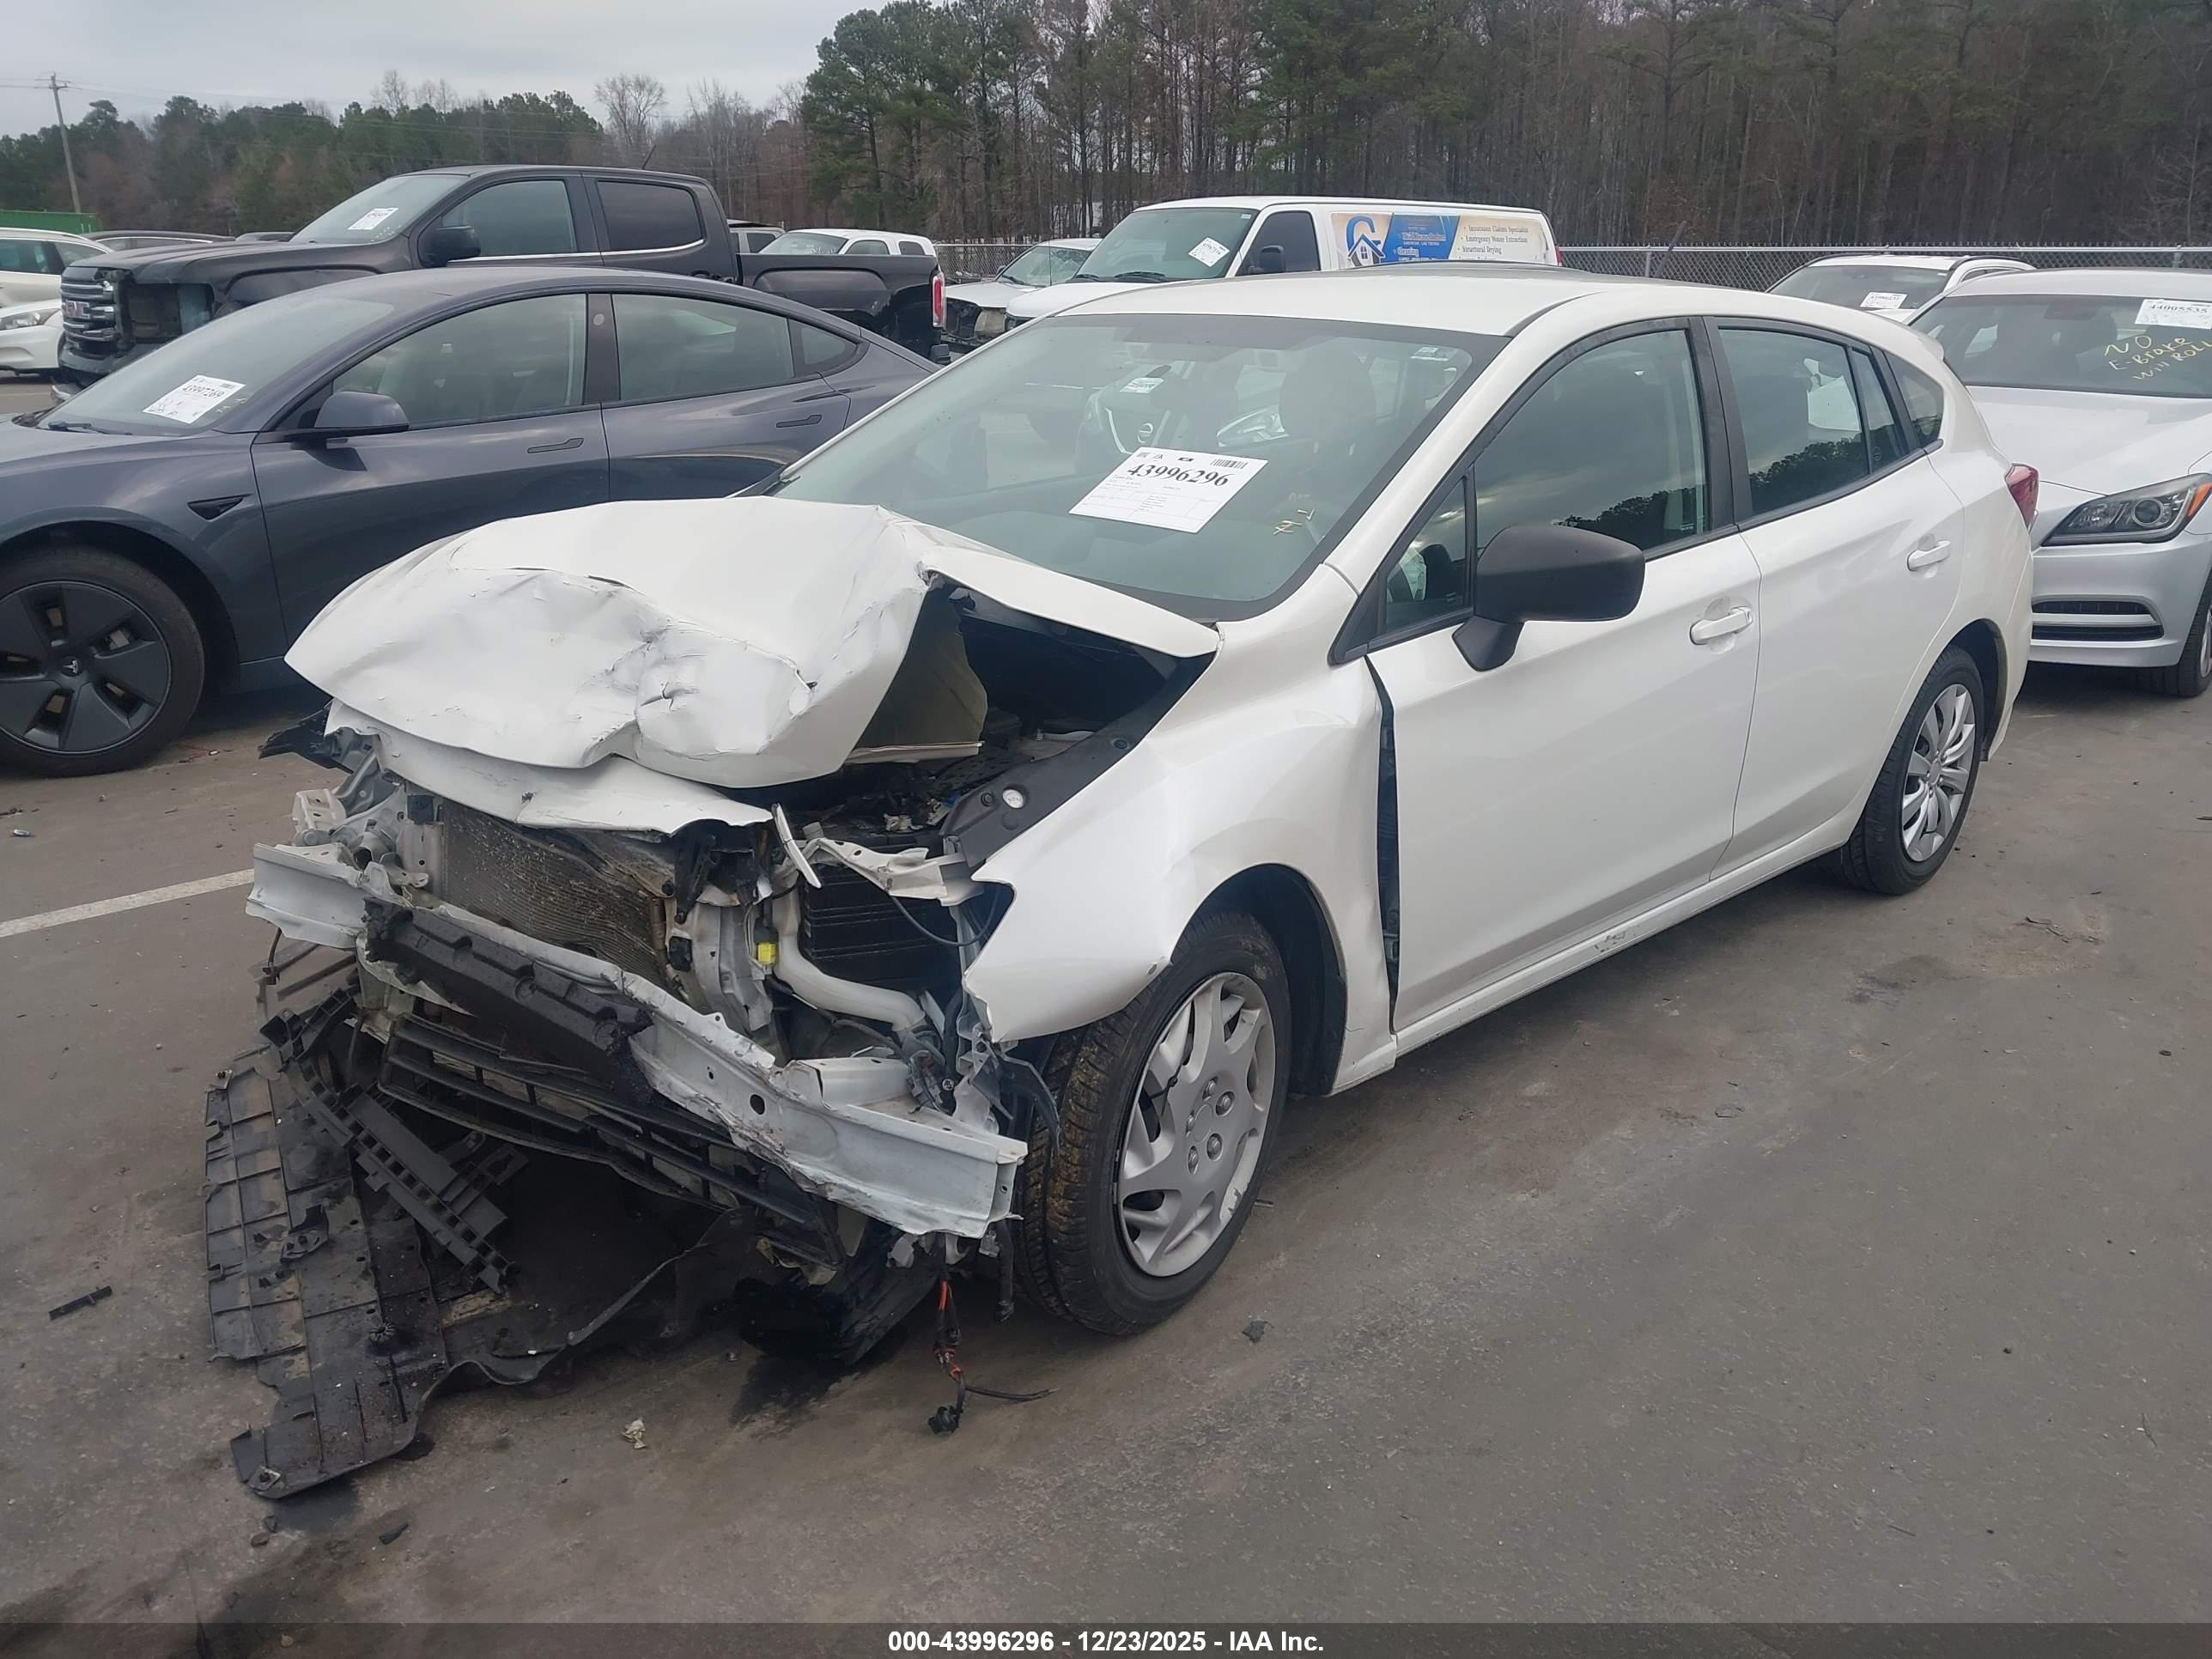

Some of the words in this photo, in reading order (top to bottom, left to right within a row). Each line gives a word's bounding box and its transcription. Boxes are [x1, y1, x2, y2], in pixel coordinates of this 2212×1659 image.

[1466, 235, 1491, 244] Emergency
[1486, 246, 1502, 254] Drying
[1127, 463, 1236, 487] 43996296
